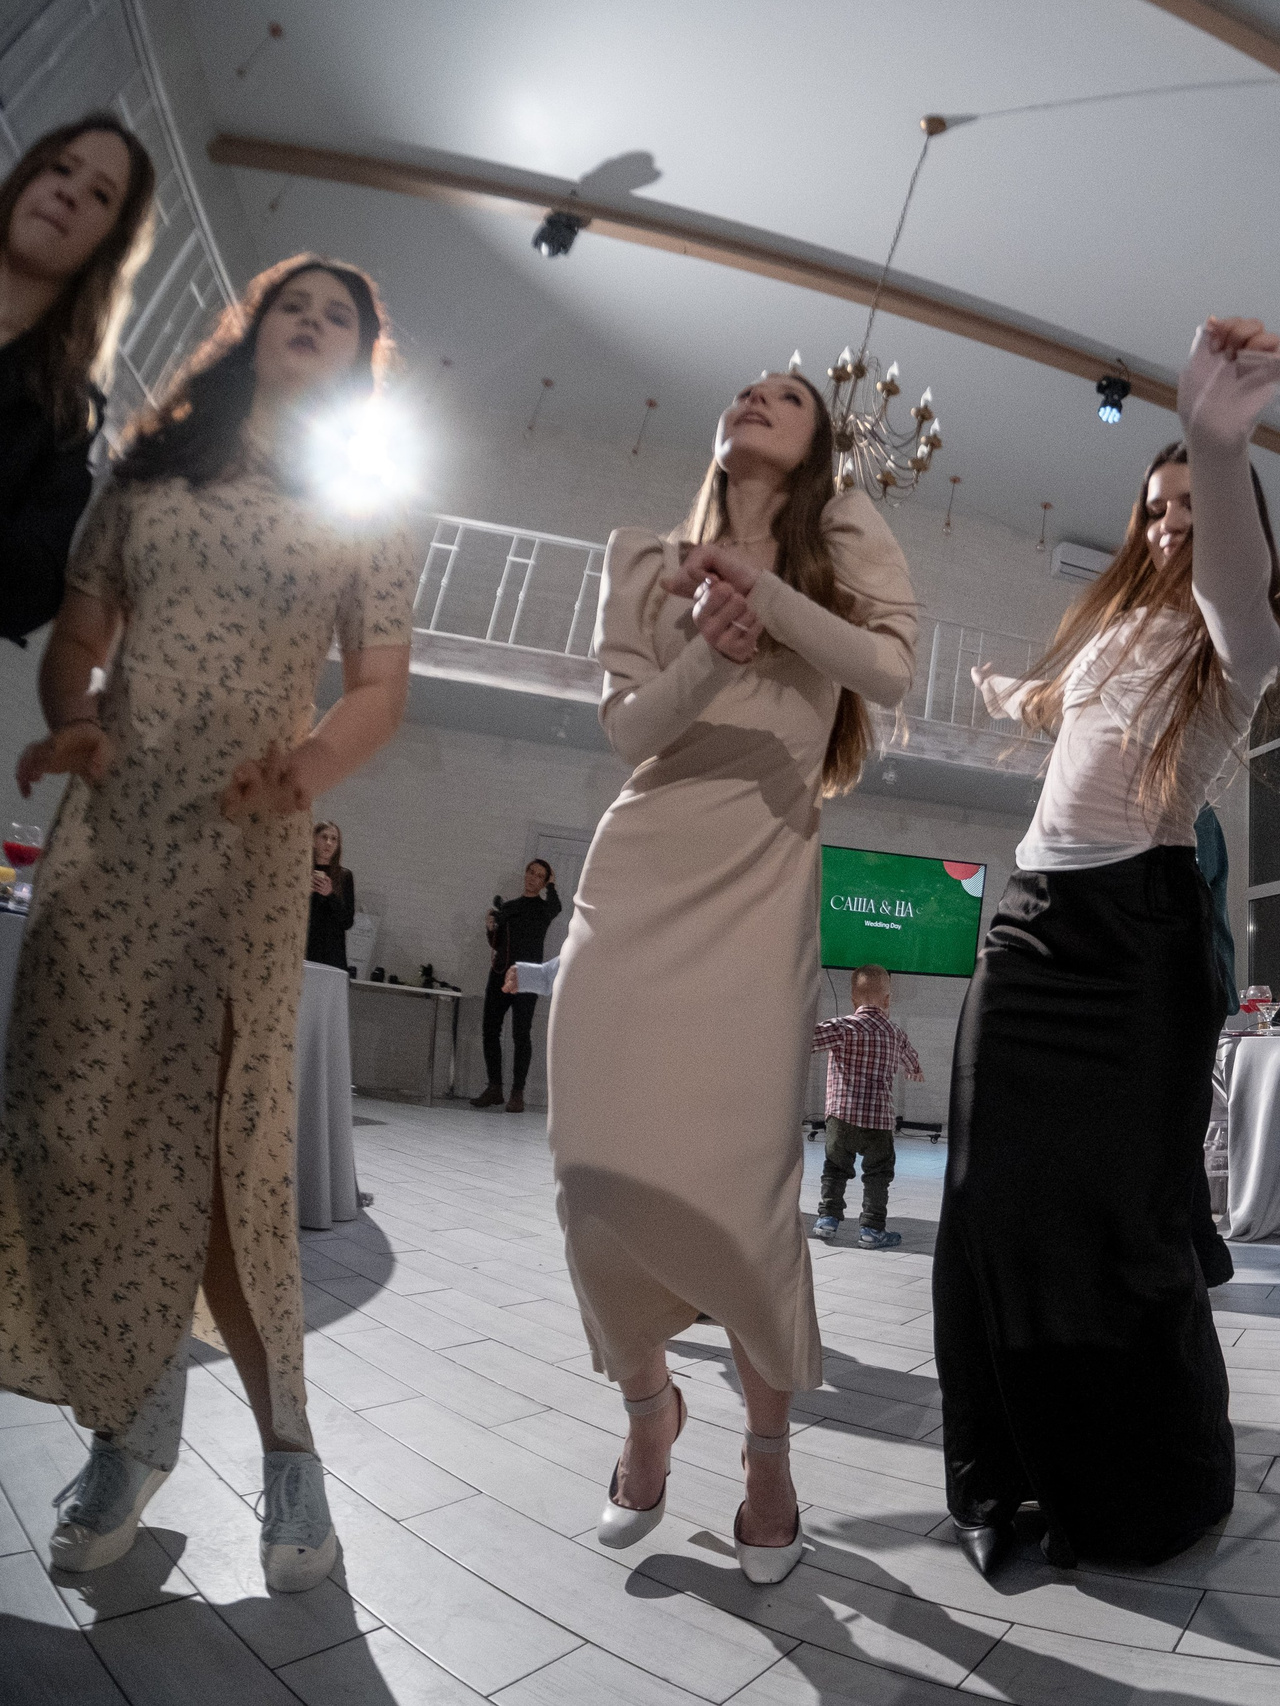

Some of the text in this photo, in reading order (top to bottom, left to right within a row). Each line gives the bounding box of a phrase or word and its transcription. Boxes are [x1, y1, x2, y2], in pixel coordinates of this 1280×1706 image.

[879, 899, 892, 916] &
[864, 920, 902, 930] Wedding Day
